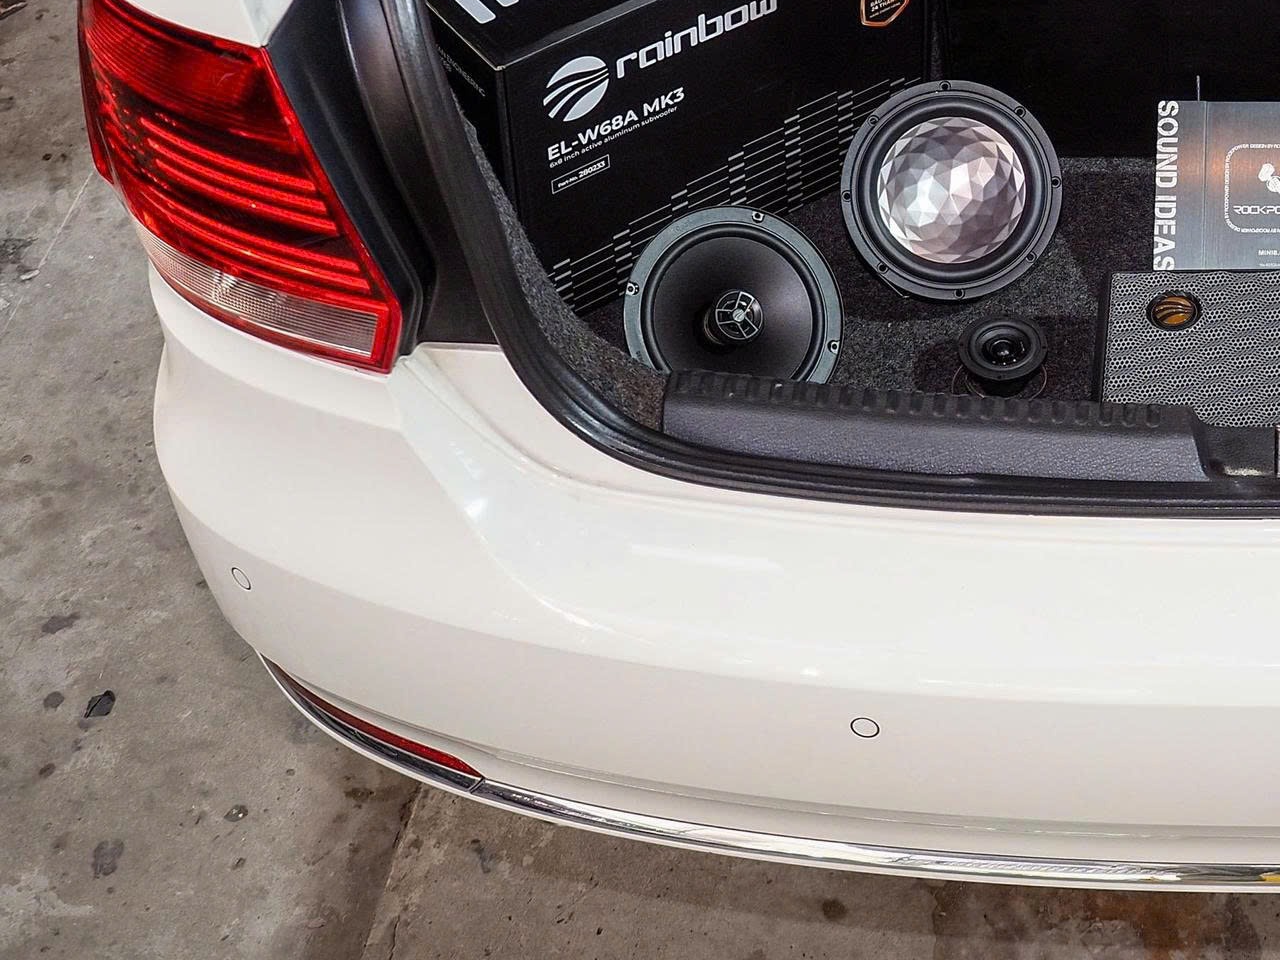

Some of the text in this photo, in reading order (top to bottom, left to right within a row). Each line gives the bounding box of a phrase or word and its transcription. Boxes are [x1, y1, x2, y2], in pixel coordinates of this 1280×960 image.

[547, 86, 685, 161] EL-W68A MK3
[563, 150, 580, 163] inch
[581, 140, 603, 154] active
[603, 122, 641, 143] aluminum
[641, 106, 678, 126] subwoofer
[1153, 100, 1179, 270] SOUND IDEAS
